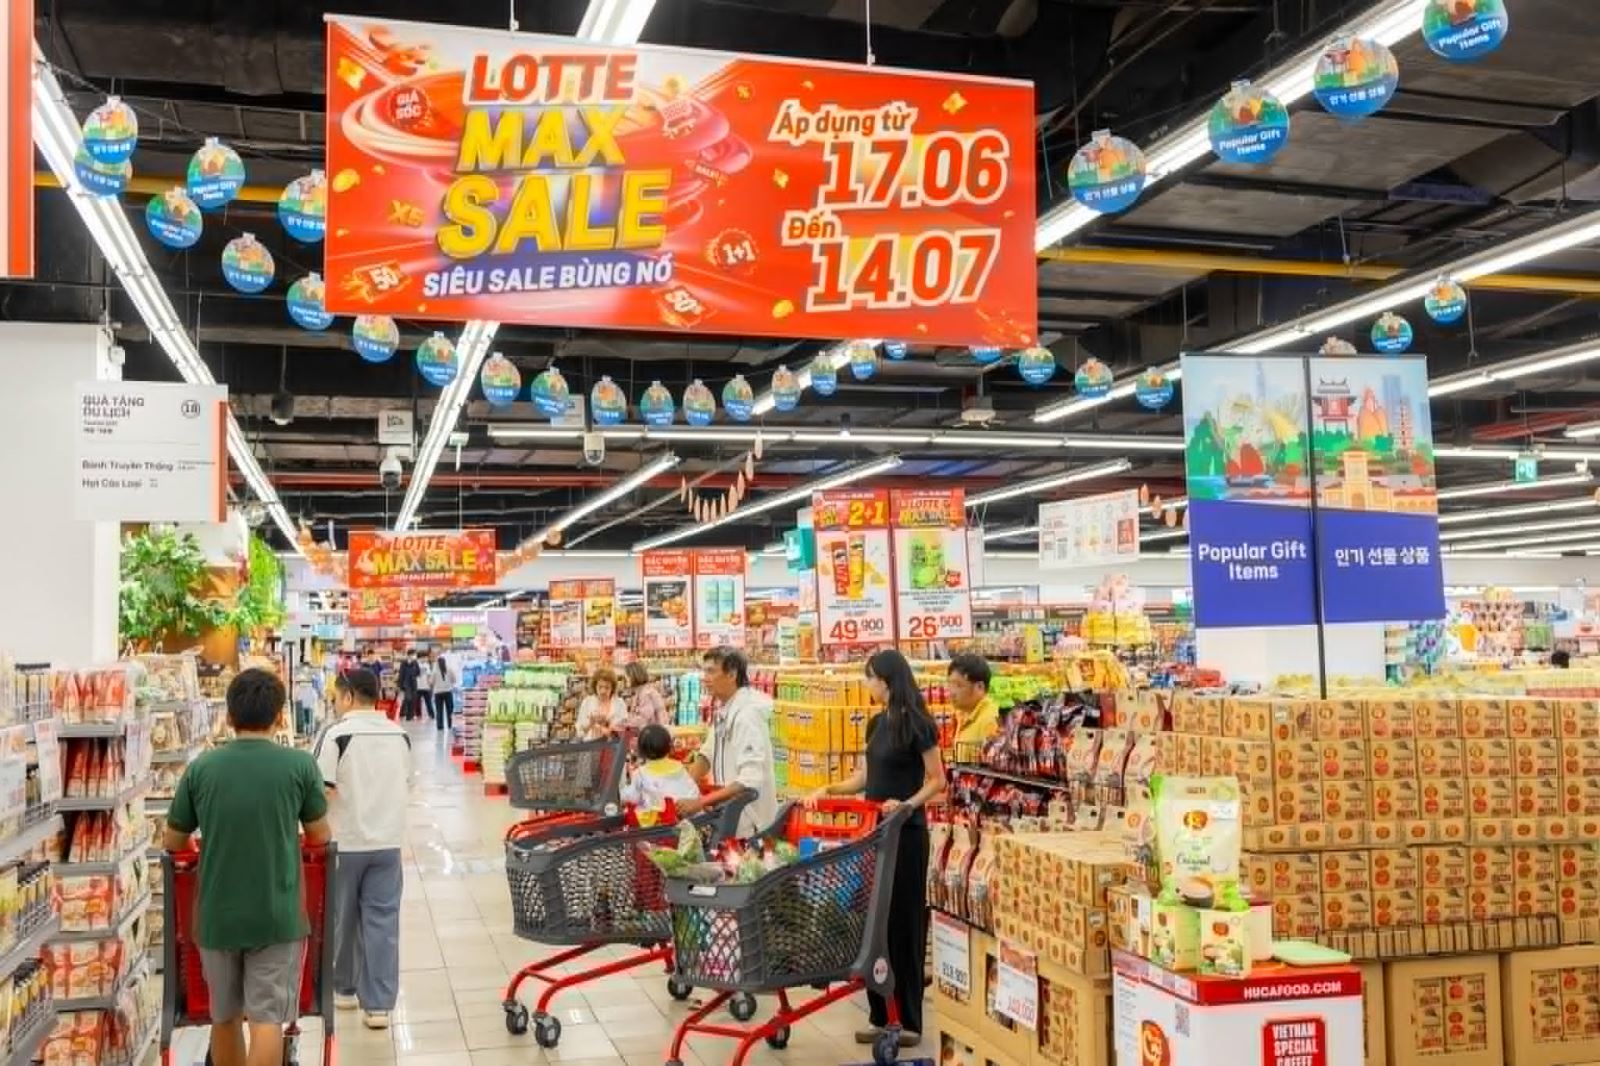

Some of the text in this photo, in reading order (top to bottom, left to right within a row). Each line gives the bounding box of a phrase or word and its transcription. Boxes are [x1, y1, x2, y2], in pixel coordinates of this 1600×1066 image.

[1439, 19, 1502, 47] Popular Gift
[471, 53, 638, 102] LOTTE
[776, 101, 912, 139] Áp dụng từ
[456, 108, 626, 171] MAX
[1219, 129, 1281, 151] Popular Gift
[823, 134, 1006, 205] 17.06
[437, 169, 671, 259] SALE
[787, 213, 836, 240] Đến
[424, 265, 483, 297] SIÊU
[488, 265, 556, 291] SALE
[560, 257, 631, 287] BÙNG
[811, 234, 996, 308] 14.07
[849, 500, 886, 526] 2+1
[393, 535, 446, 551] LOTTE
[1198, 541, 1307, 562] Popular Gift
[373, 548, 477, 575] MAX SALE
[1229, 562, 1279, 580] Items
[1335, 548, 1364, 568] 인기
[1272, 1022, 1316, 1039] VIETNAM
[1274, 1038, 1319, 1056] SPECIAL
